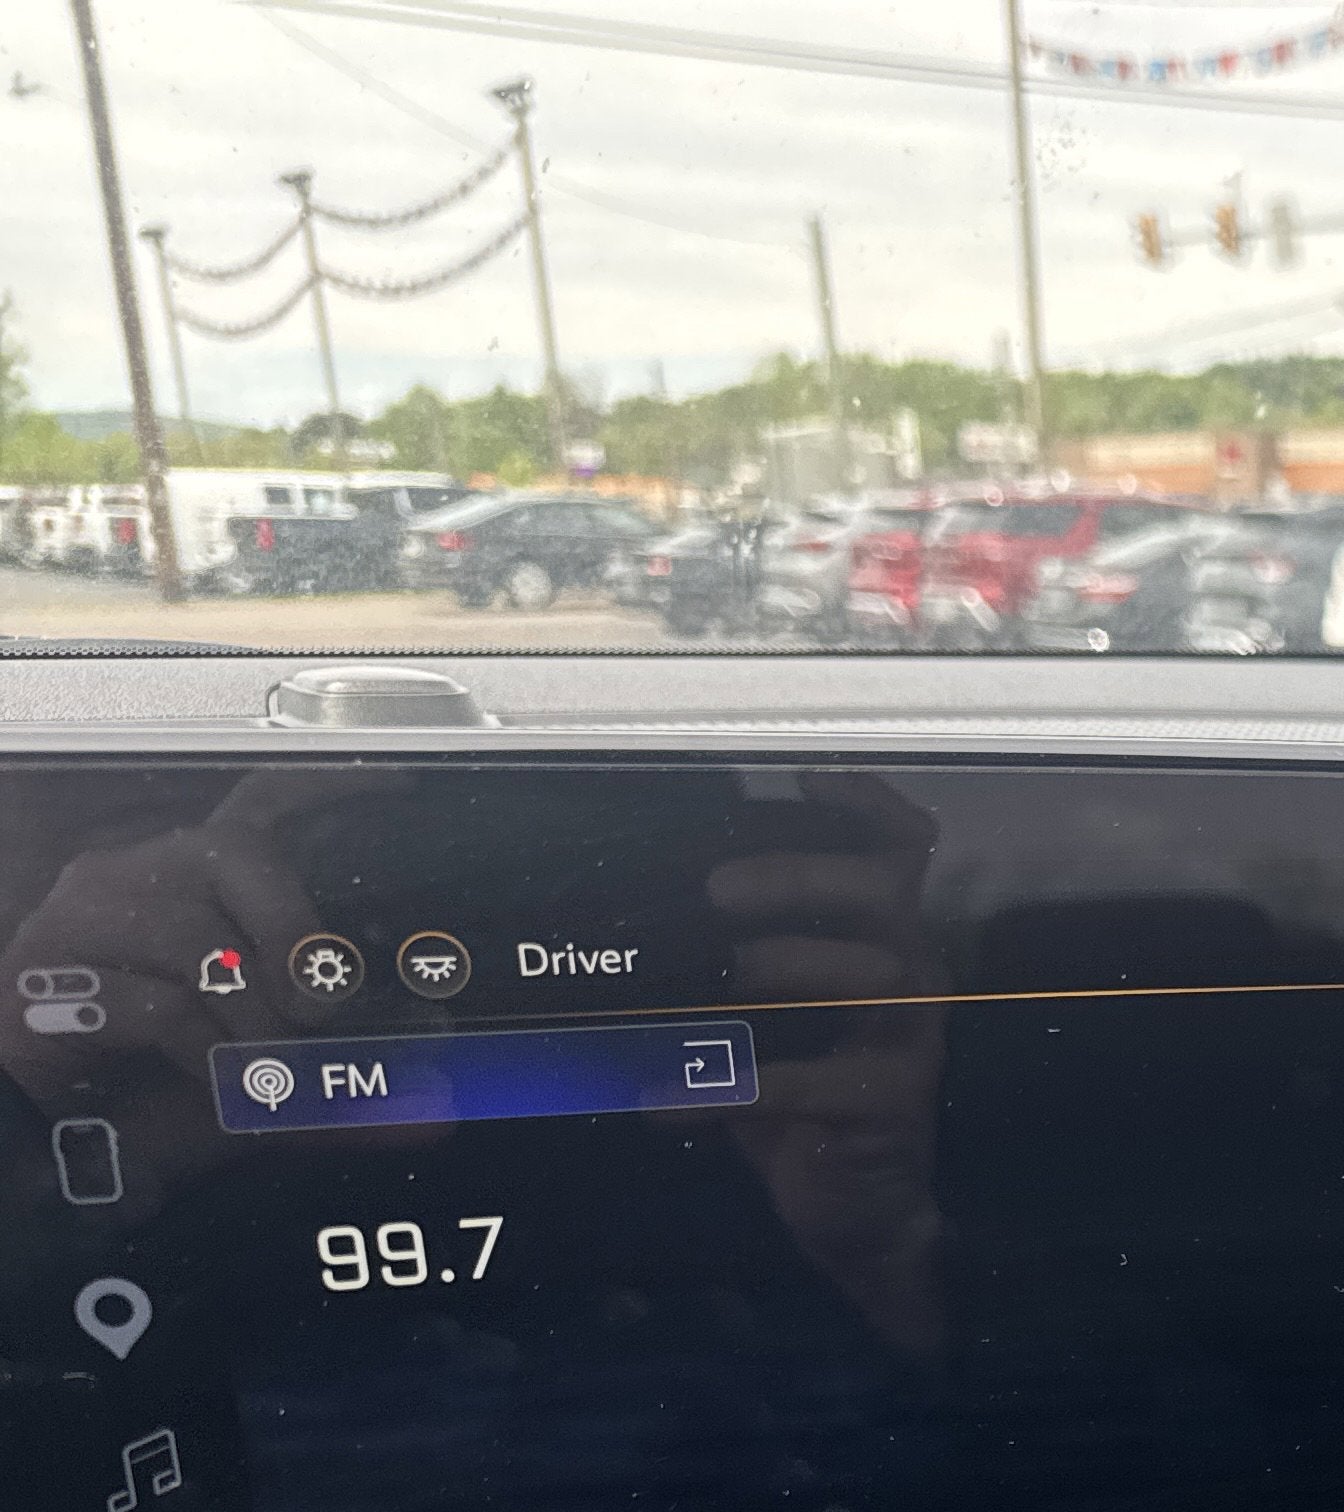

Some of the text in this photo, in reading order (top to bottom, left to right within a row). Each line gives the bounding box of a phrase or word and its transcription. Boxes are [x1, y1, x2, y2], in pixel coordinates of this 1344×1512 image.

[516, 940, 640, 978] Driver
[320, 1061, 389, 1101] FM
[316, 1215, 505, 1292] 99.7
